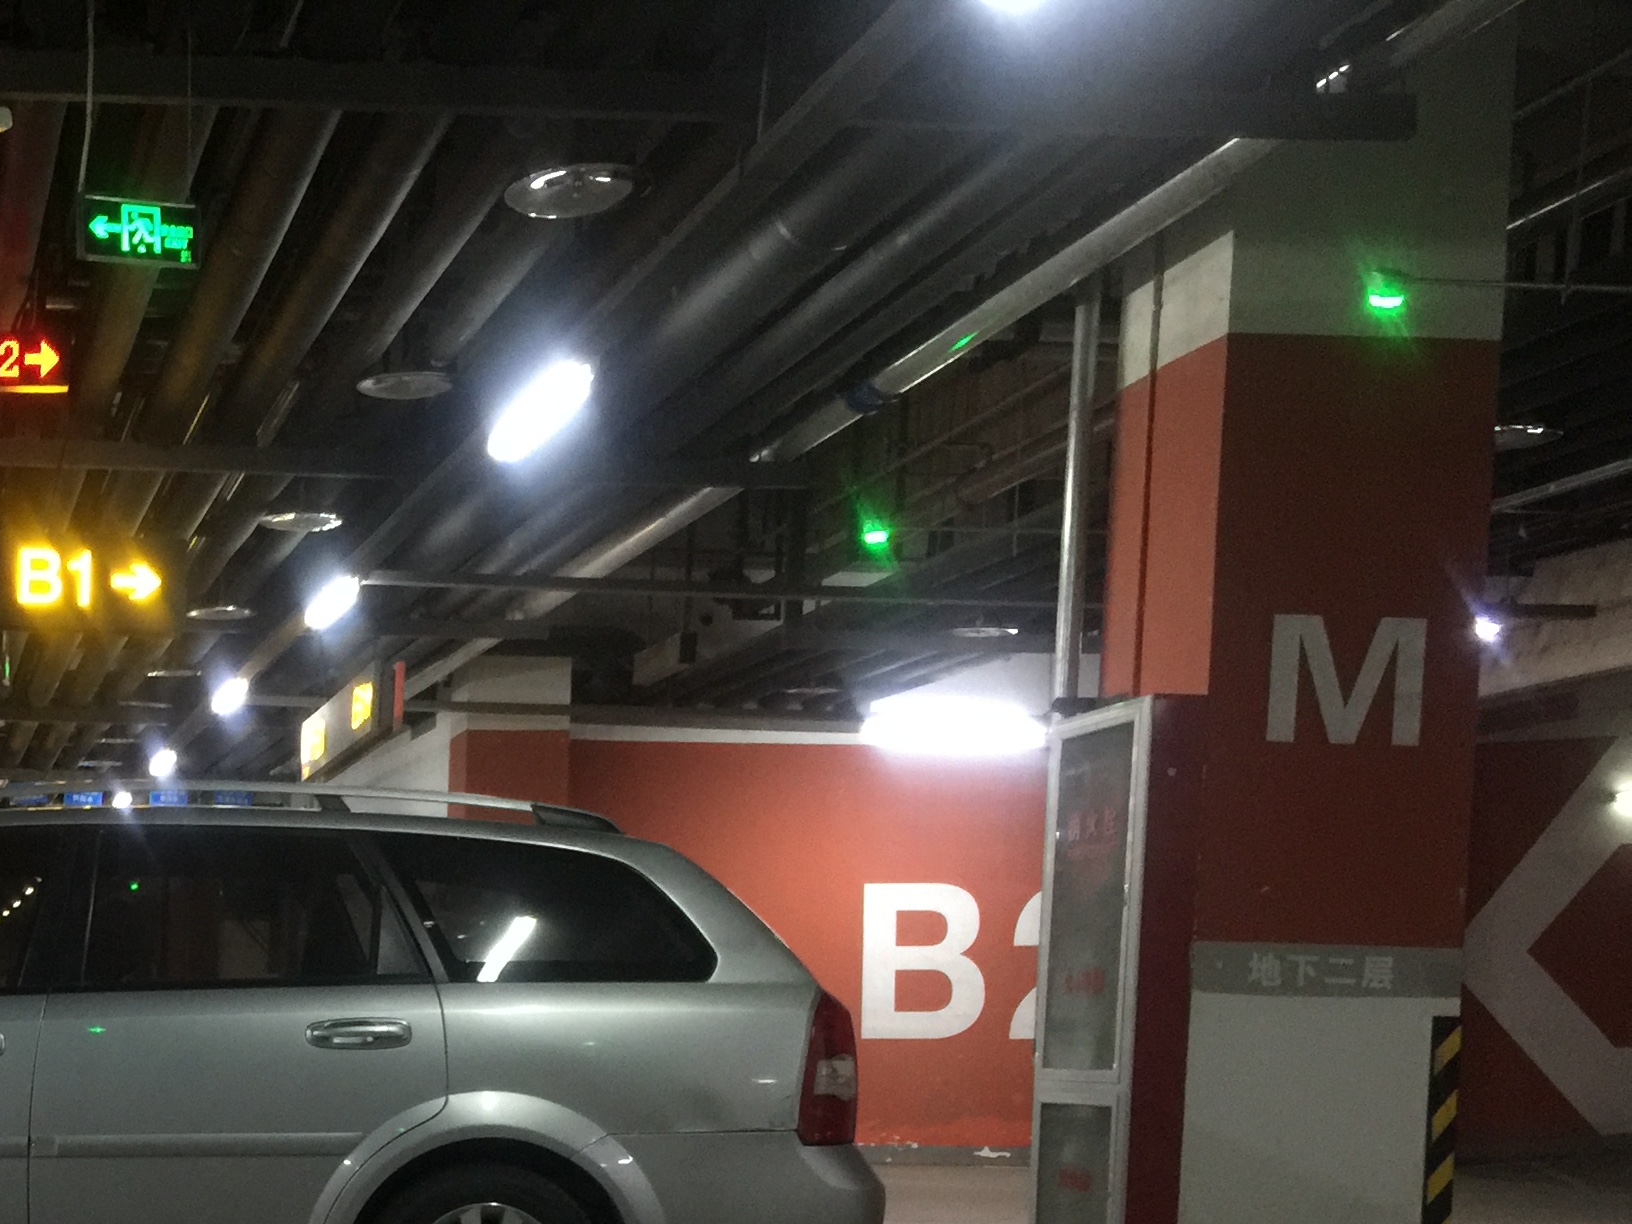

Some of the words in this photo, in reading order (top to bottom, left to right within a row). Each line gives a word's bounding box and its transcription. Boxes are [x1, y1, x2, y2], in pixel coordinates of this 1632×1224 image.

[16, 545, 93, 608] B1
[1266, 614, 1428, 747] M
[1247, 951, 1396, 993] 地下二层
